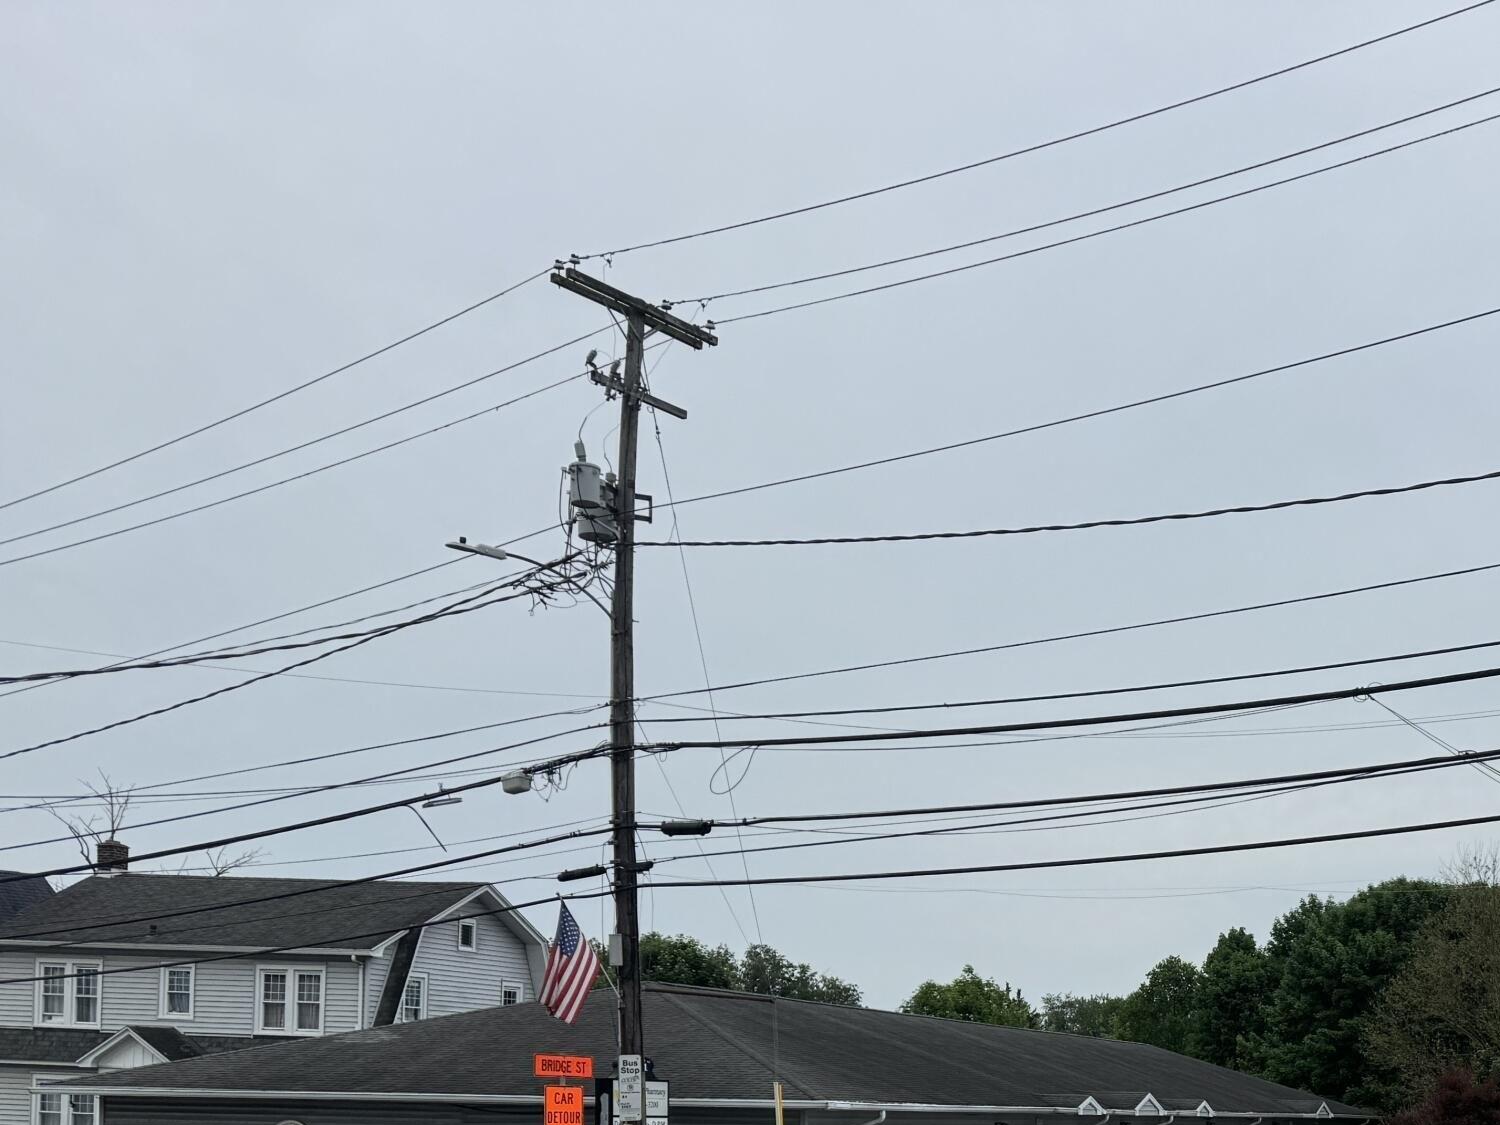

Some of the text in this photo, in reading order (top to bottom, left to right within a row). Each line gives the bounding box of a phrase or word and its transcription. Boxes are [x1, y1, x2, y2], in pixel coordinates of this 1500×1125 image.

[541, 1059, 587, 1074] BRIDGE ST
[622, 1059, 638, 1067] Bus
[620, 1066, 640, 1075] Stop
[554, 1092, 574, 1105] CAR
[547, 1111, 581, 1124] DETOUR
